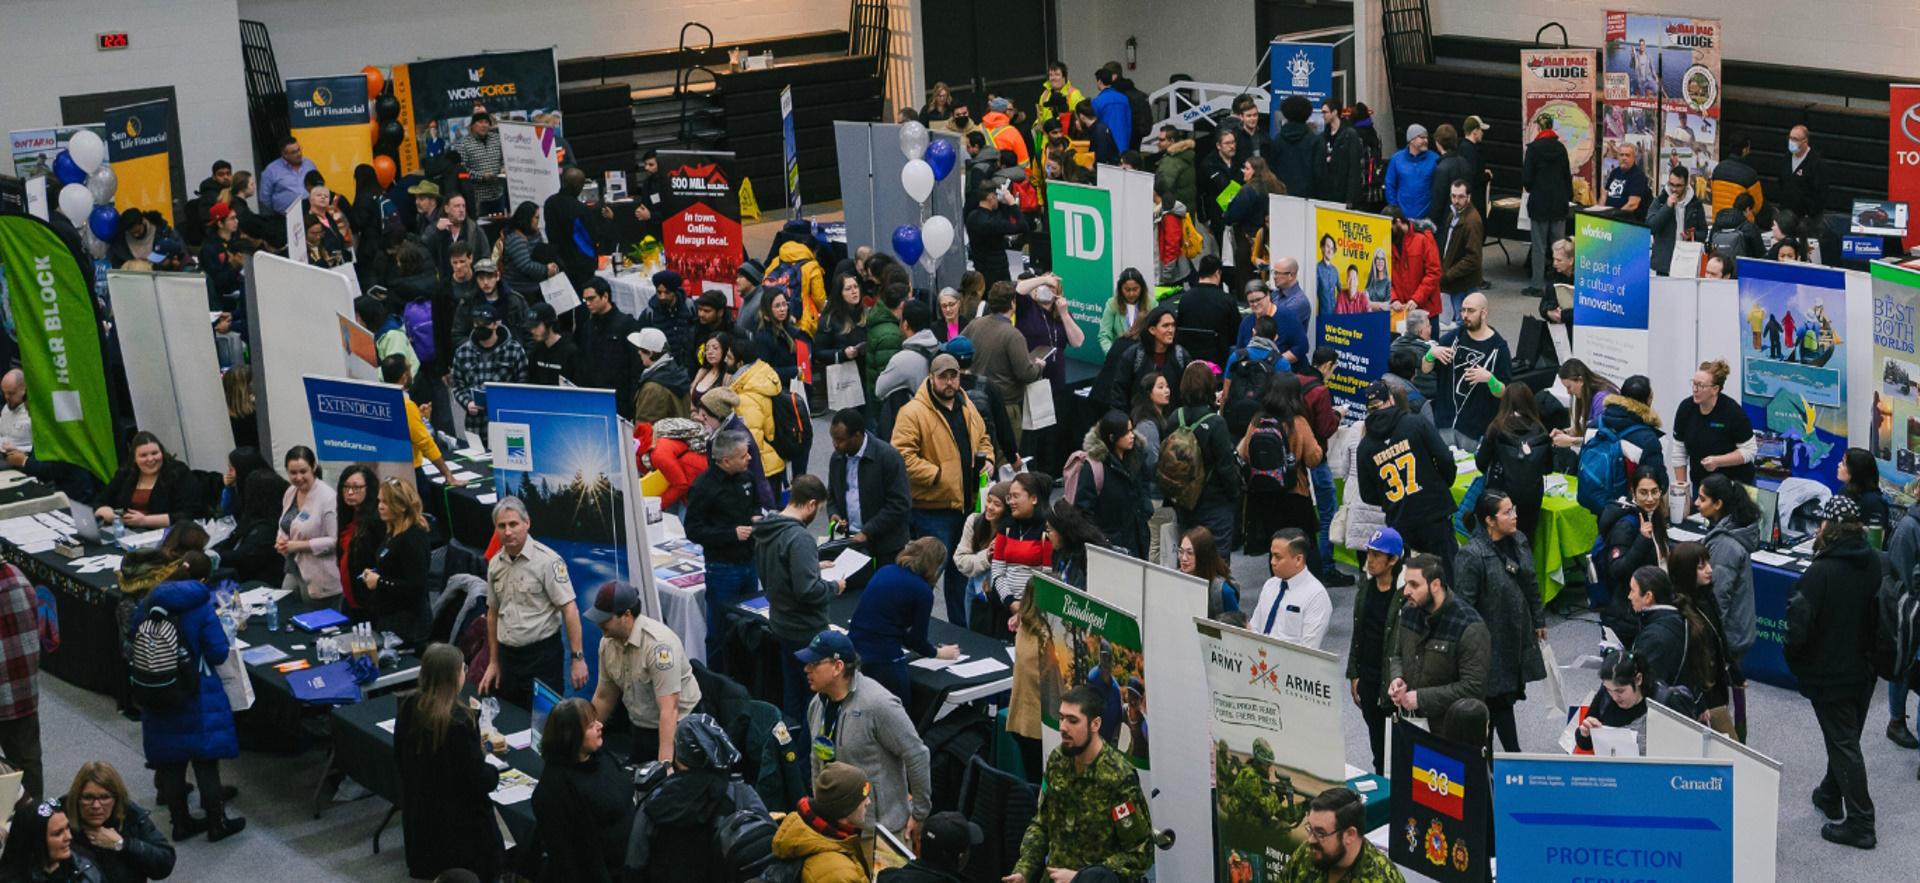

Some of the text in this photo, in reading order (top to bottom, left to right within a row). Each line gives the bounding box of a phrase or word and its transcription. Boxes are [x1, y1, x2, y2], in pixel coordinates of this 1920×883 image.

[1676, 34, 1714, 48] LODGE
[1543, 66, 1588, 78] LODGE
[447, 83, 517, 101] WORKFORCE
[294, 99, 312, 109] Sun
[304, 105, 365, 117] Life Financial
[14, 136, 55, 148] ONTARIO
[111, 131, 127, 141] Sun
[119, 131, 168, 150] Life Financial
[1896, 151, 1920, 165] TO
[671, 177, 688, 189] SOO
[688, 178, 706, 189] MILL
[684, 212, 717, 222] In town.
[687, 223, 716, 234] Online.
[1053, 200, 1105, 261] TD
[1338, 219, 1368, 234] THE FIVE
[1581, 224, 1612, 242] workiva
[675, 234, 729, 247] Always local.
[1342, 229, 1372, 243] TRUTHS
[1343, 248, 1370, 261] LIVE BY
[1580, 256, 1622, 276] Be part of
[1587, 277, 1615, 293] culture
[1616, 284, 1625, 296] of
[1578, 291, 1625, 315] innovation.
[1873, 298, 1915, 324] BEST
[34, 256, 70, 384] H&R BLOCK
[1325, 324, 1336, 334] We
[1873, 316, 1914, 342] BOTH
[1873, 334, 1915, 354] WORLDS
[1346, 352, 1360, 365] Play
[1348, 361, 1367, 374] Team
[317, 394, 393, 421] EXTENDICARE
[323, 440, 378, 452] extendicare.com
[1372, 439, 1411, 467] BERGERON
[1379, 452, 1421, 503] 37
[1211, 650, 1243, 673] ARMY
[1286, 674, 1331, 700] ARMÉE
[1428, 768, 1449, 796] 33
[1670, 775, 1723, 791] Canada
[1546, 847, 1684, 870] PROTECTION
